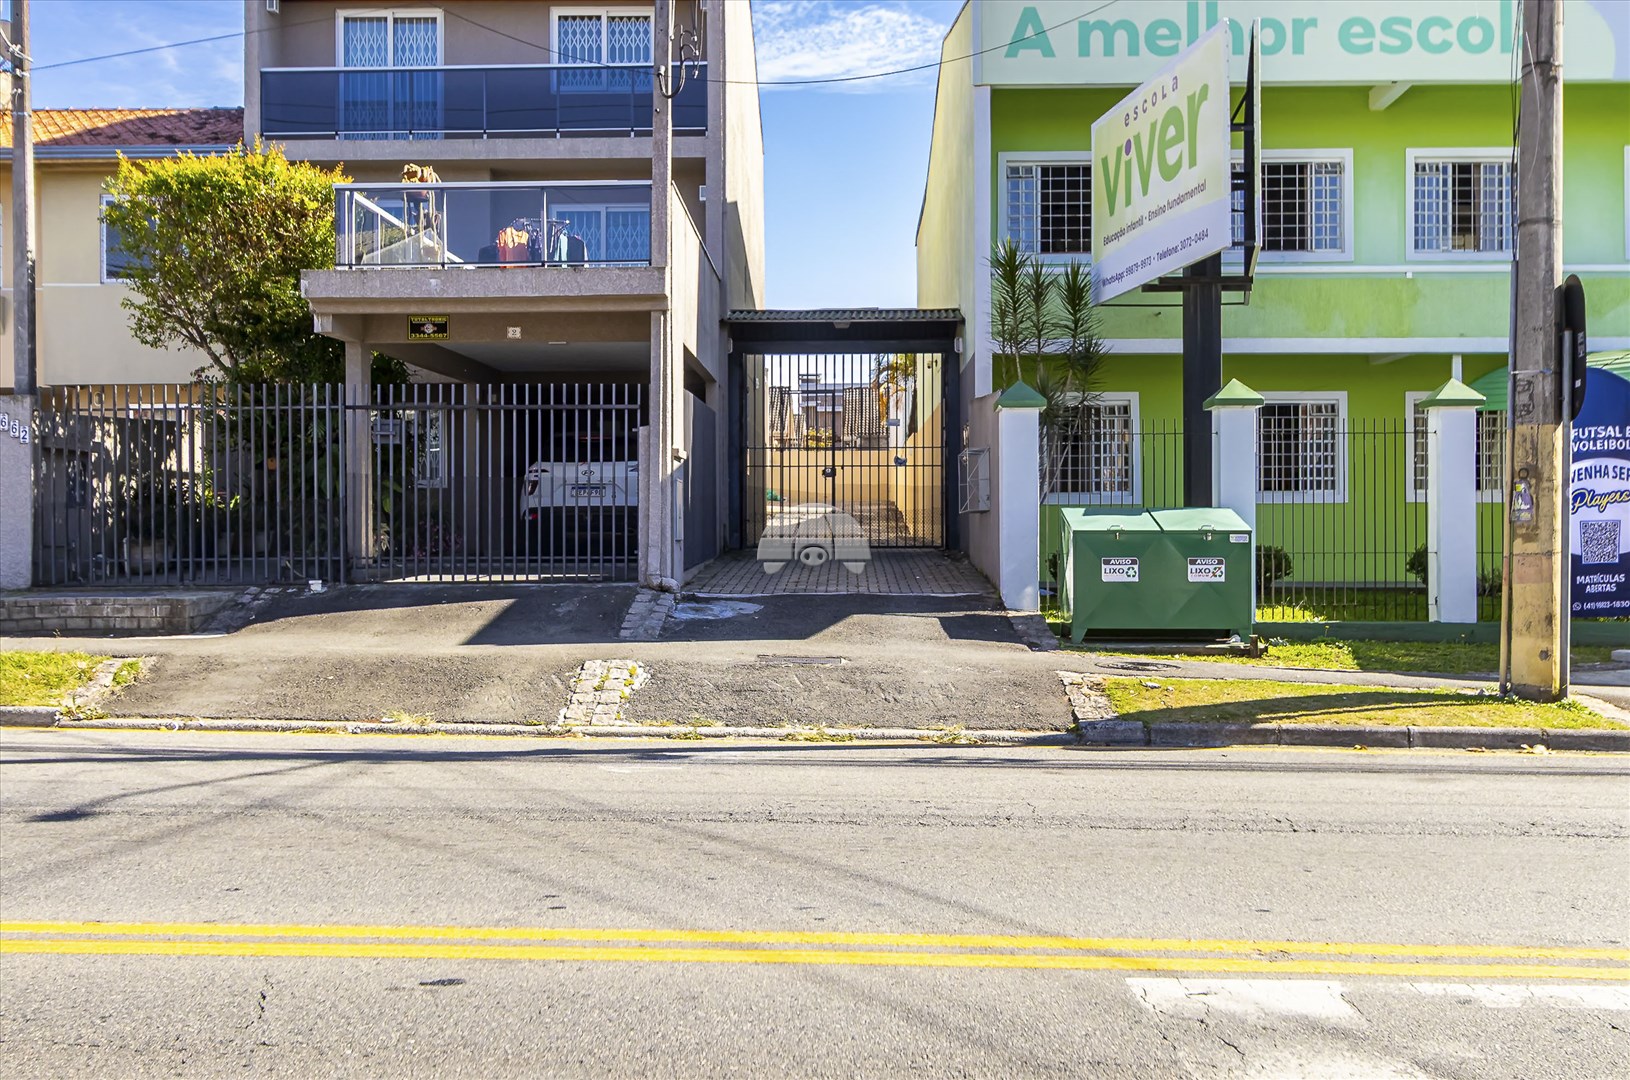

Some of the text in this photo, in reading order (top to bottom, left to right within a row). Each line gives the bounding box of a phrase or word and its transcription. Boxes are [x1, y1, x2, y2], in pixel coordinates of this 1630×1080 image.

[1004, 0, 1523, 58] A melhor escol
[1103, 178, 1207, 246] Educação infantil Ensino fundamental
[1156, 244, 1180, 262] Telefone:
[1572, 425, 1623, 440] FUTSAL
[1104, 567, 1125, 575] LIXO
[1190, 567, 1211, 575] LIXO
[1576, 572, 1626, 585] MATRÍCULAS
[1585, 583, 1617, 594] ABERTAS
